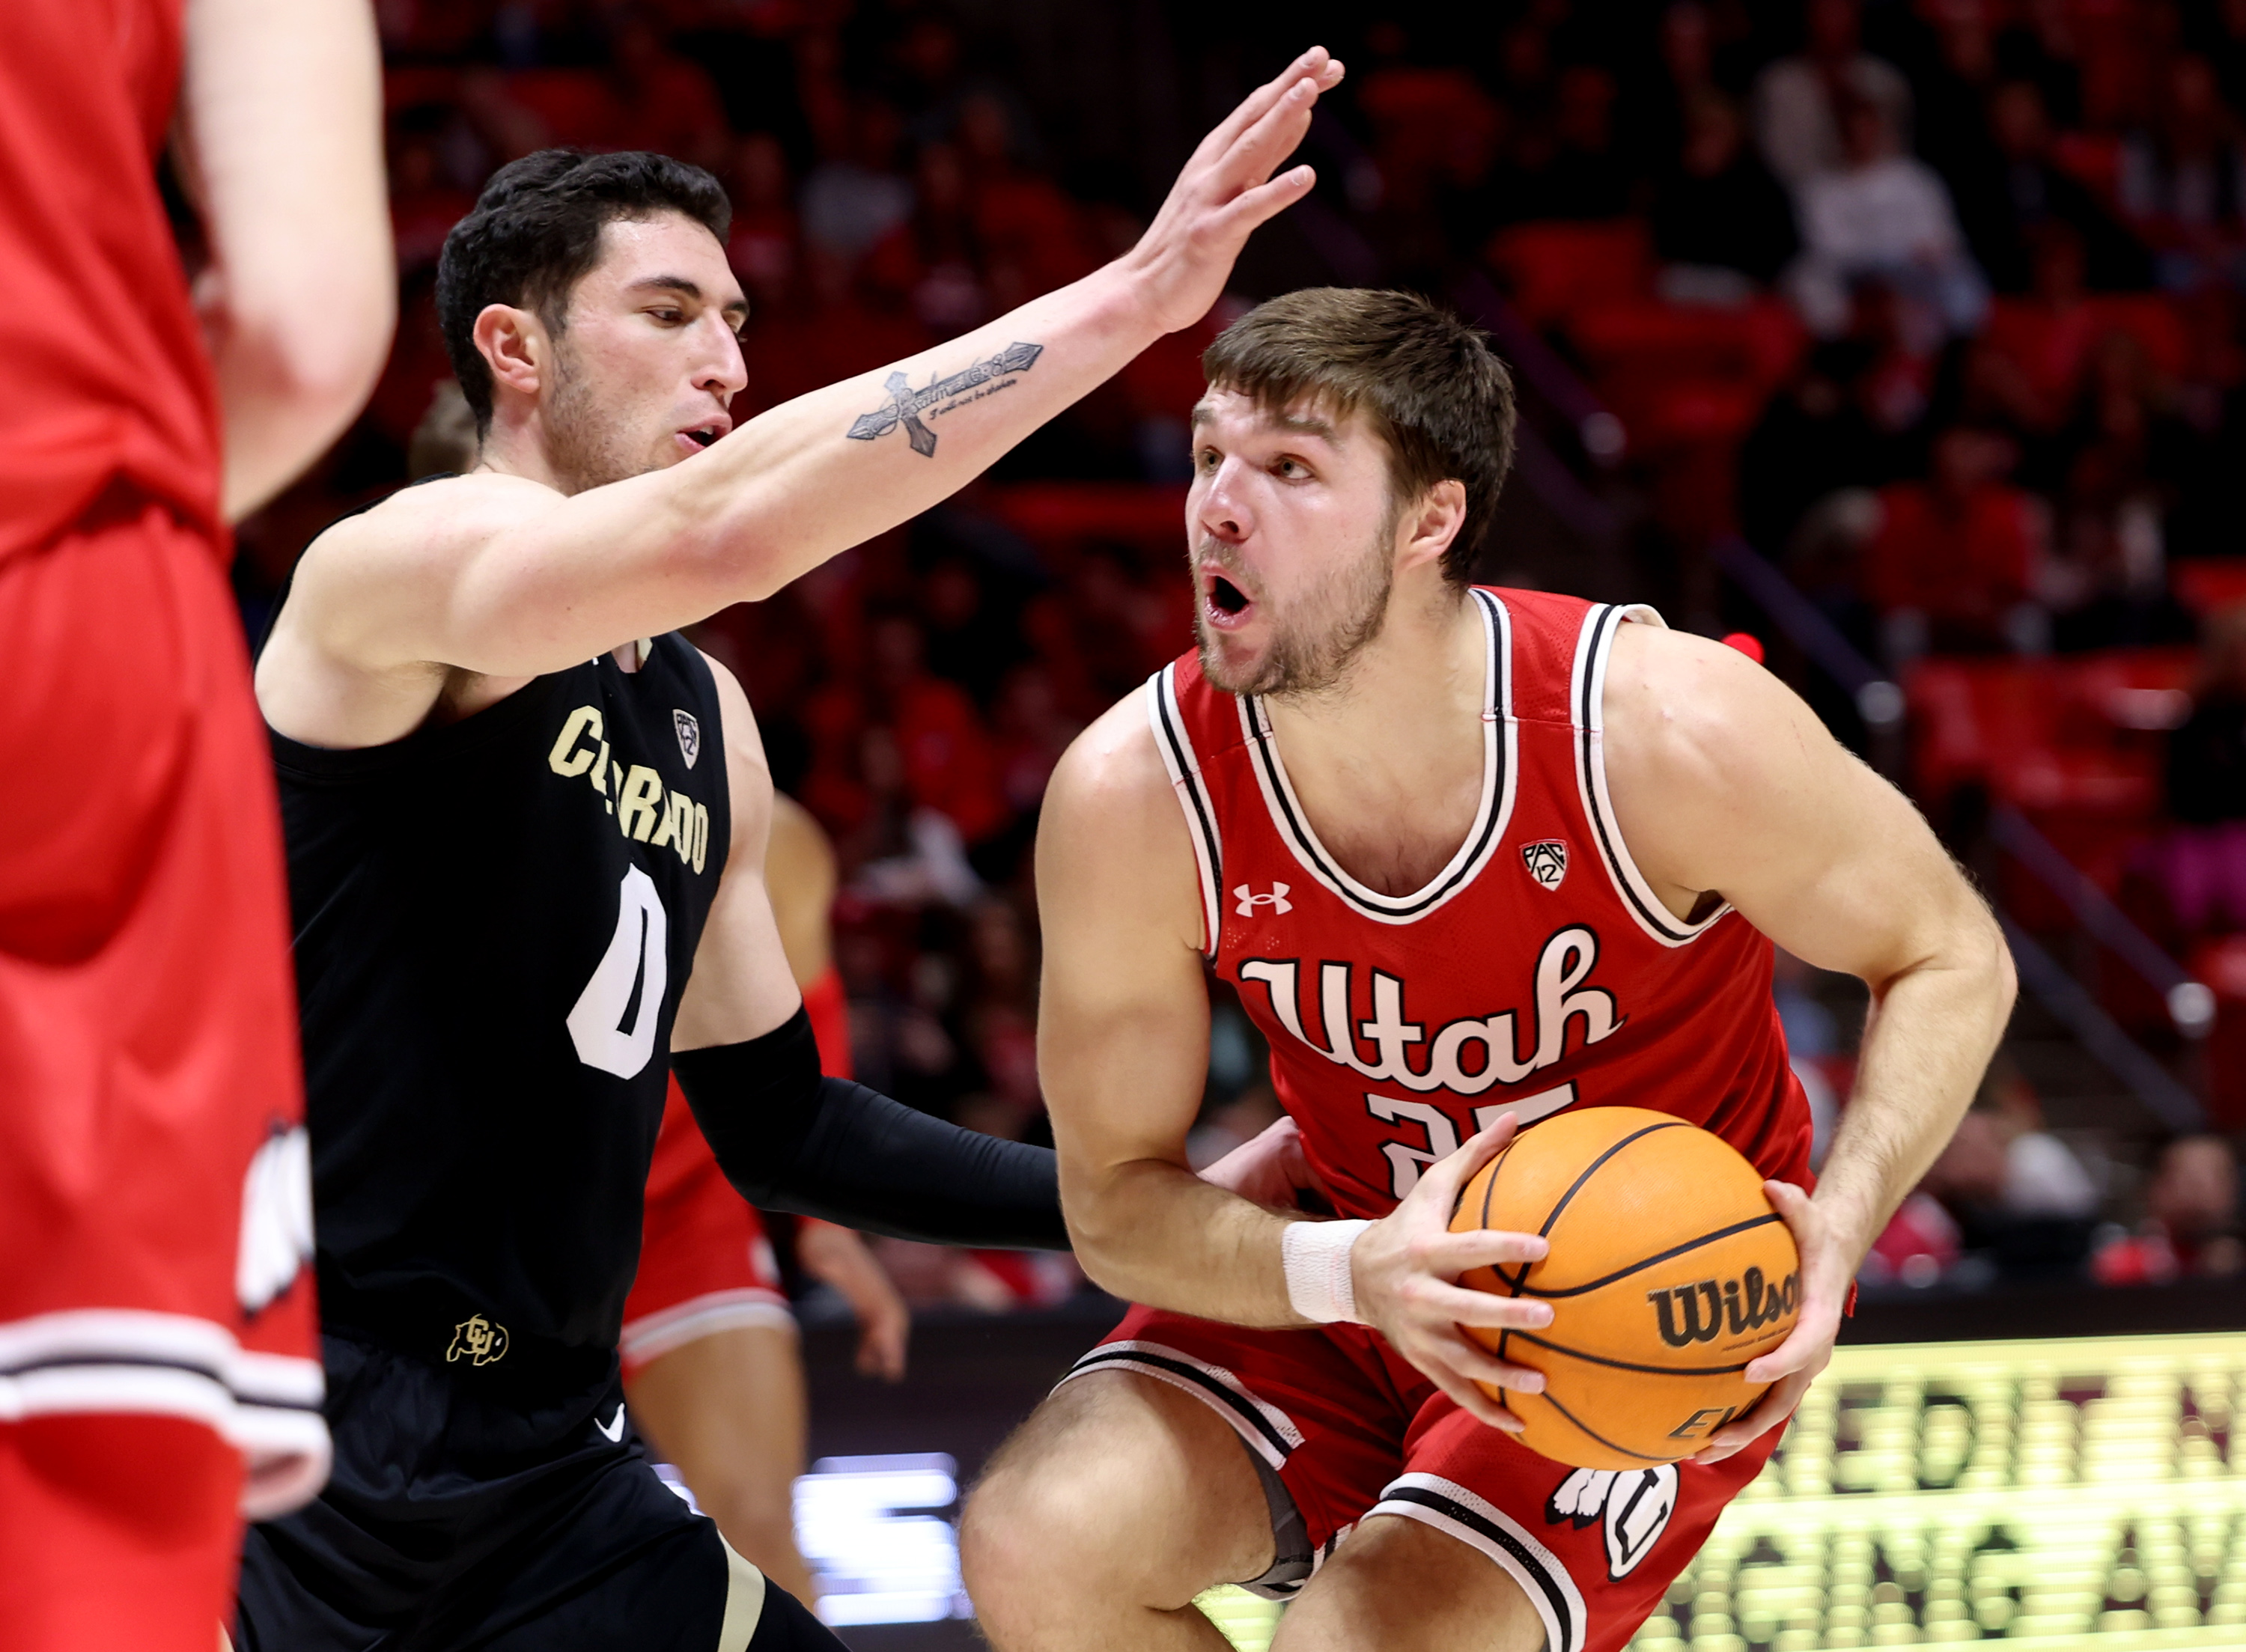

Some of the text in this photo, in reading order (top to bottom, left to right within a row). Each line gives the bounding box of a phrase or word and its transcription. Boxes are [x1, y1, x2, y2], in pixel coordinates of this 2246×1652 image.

[548, 705, 709, 875] CRADO
[1523, 844, 1565, 874] PAC
[1537, 864, 1560, 883] 12
[566, 862, 668, 1080] 0
[1238, 924, 1629, 1095] Utah
[466, 1318, 495, 1355] CU
[1646, 1266, 1801, 1347] Wilso
[1771, 1371, 2116, 1499] EDIT
